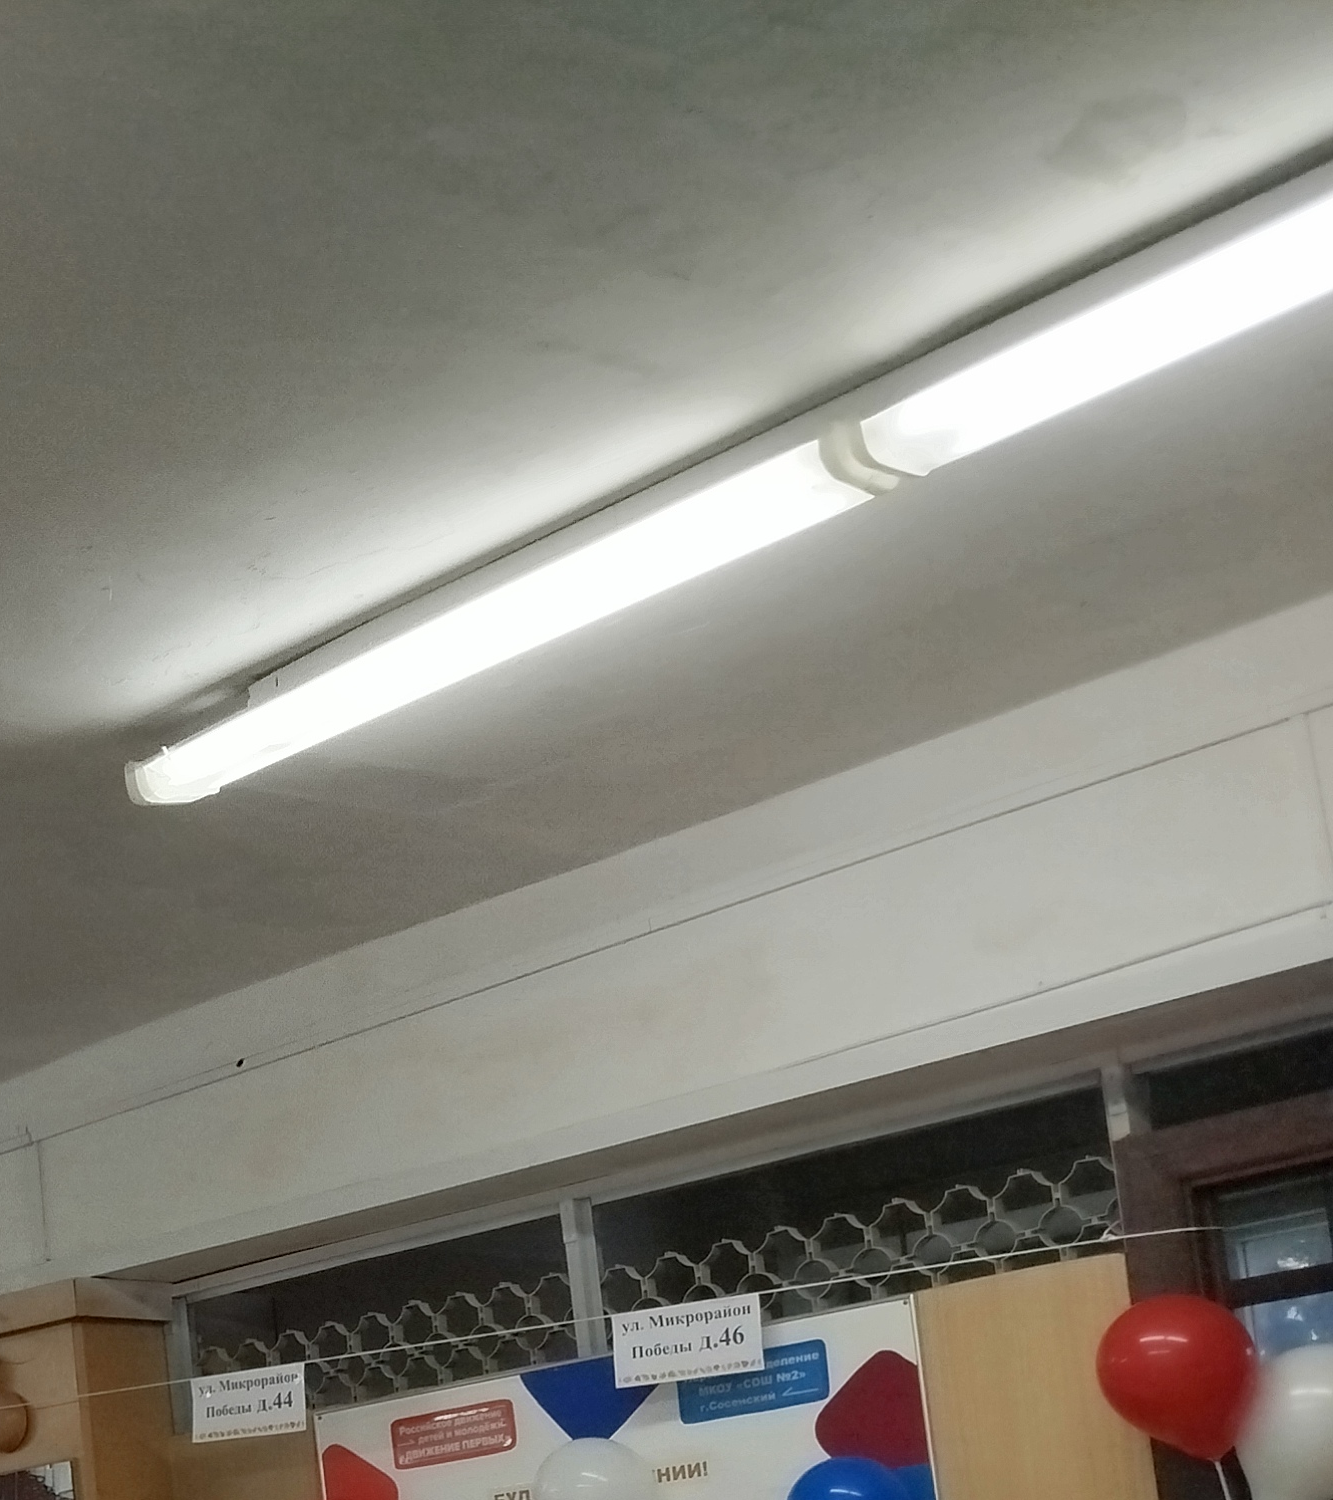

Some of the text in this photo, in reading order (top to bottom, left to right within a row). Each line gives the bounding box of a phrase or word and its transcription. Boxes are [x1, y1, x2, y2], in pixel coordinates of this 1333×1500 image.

[621, 1304, 751, 1336] ул. Микрорайон
[631, 1341, 692, 1359] Победы
[219, 1373, 299, 1392] Микрорайон
[206, 1403, 252, 1419] Победы
[398, 1441, 461, 1465] «ДВИЖЕНИЕ
